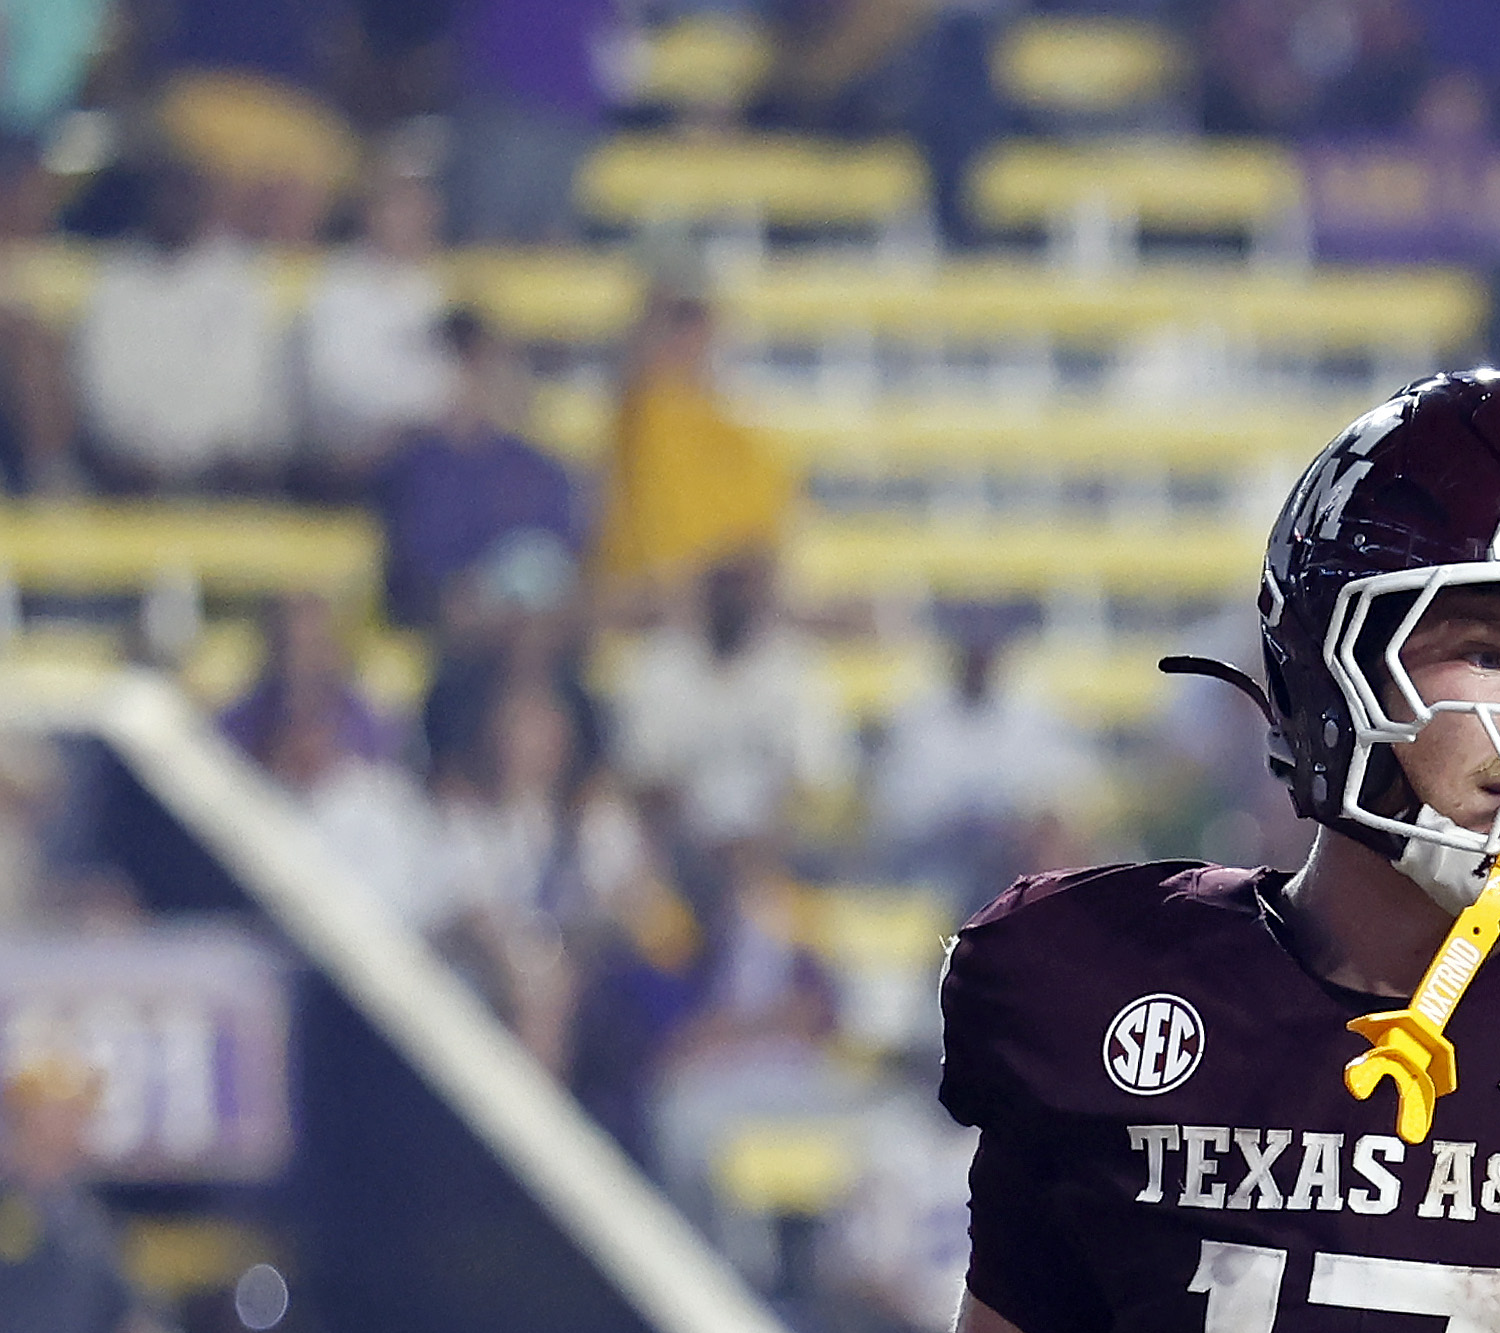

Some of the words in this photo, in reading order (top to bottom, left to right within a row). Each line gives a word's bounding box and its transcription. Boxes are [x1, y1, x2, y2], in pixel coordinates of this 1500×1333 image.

[1417, 937, 1481, 1026] NXTRND
[1114, 1004, 1196, 1086] SEC
[1127, 1124, 1405, 1216] TEXAS
